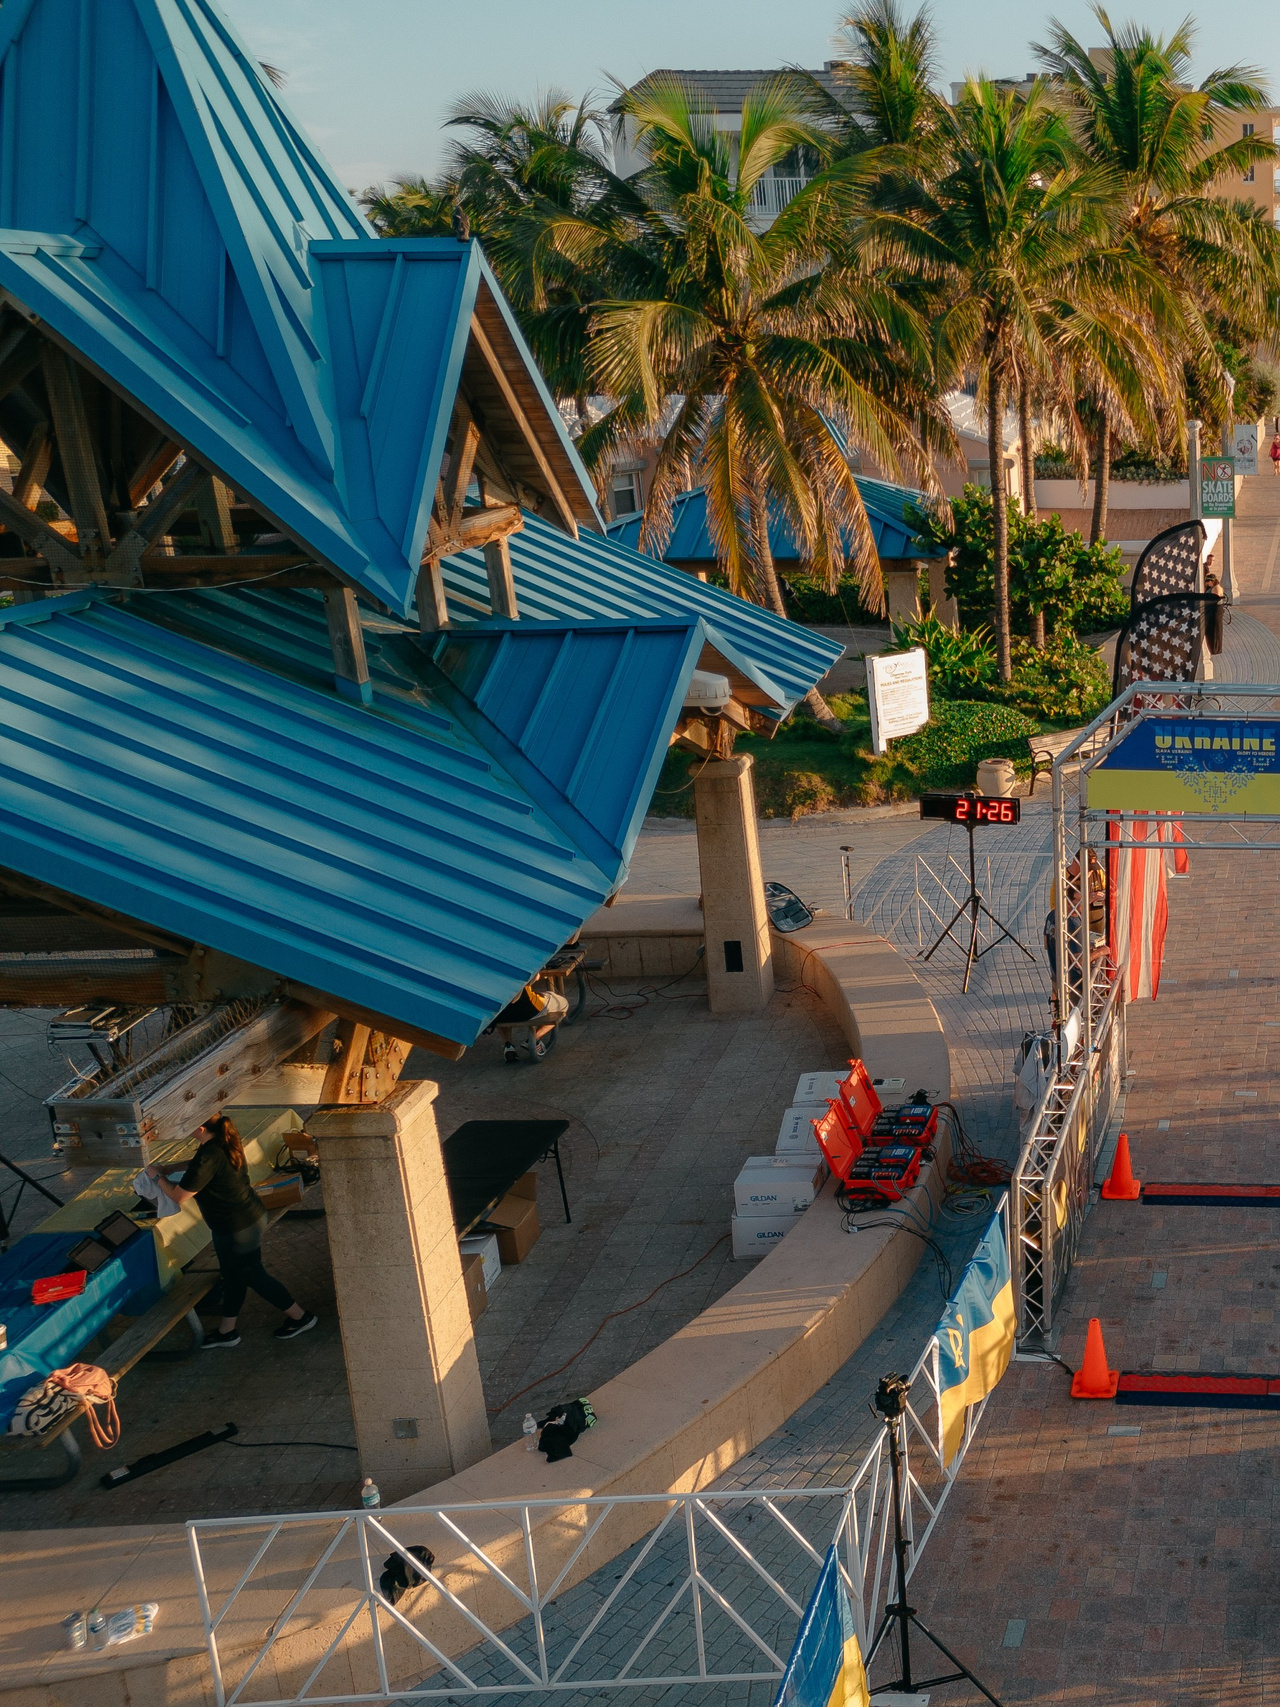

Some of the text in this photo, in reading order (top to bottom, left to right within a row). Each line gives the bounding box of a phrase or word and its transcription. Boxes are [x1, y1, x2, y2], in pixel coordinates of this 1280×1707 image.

[1202, 462, 1233, 480] NO
[1202, 481, 1233, 493] SKATE
[1203, 493, 1233, 502] BOARDS
[1155, 725, 1276, 750] UKRAINE
[756, 1231, 784, 1239] GILDAN
